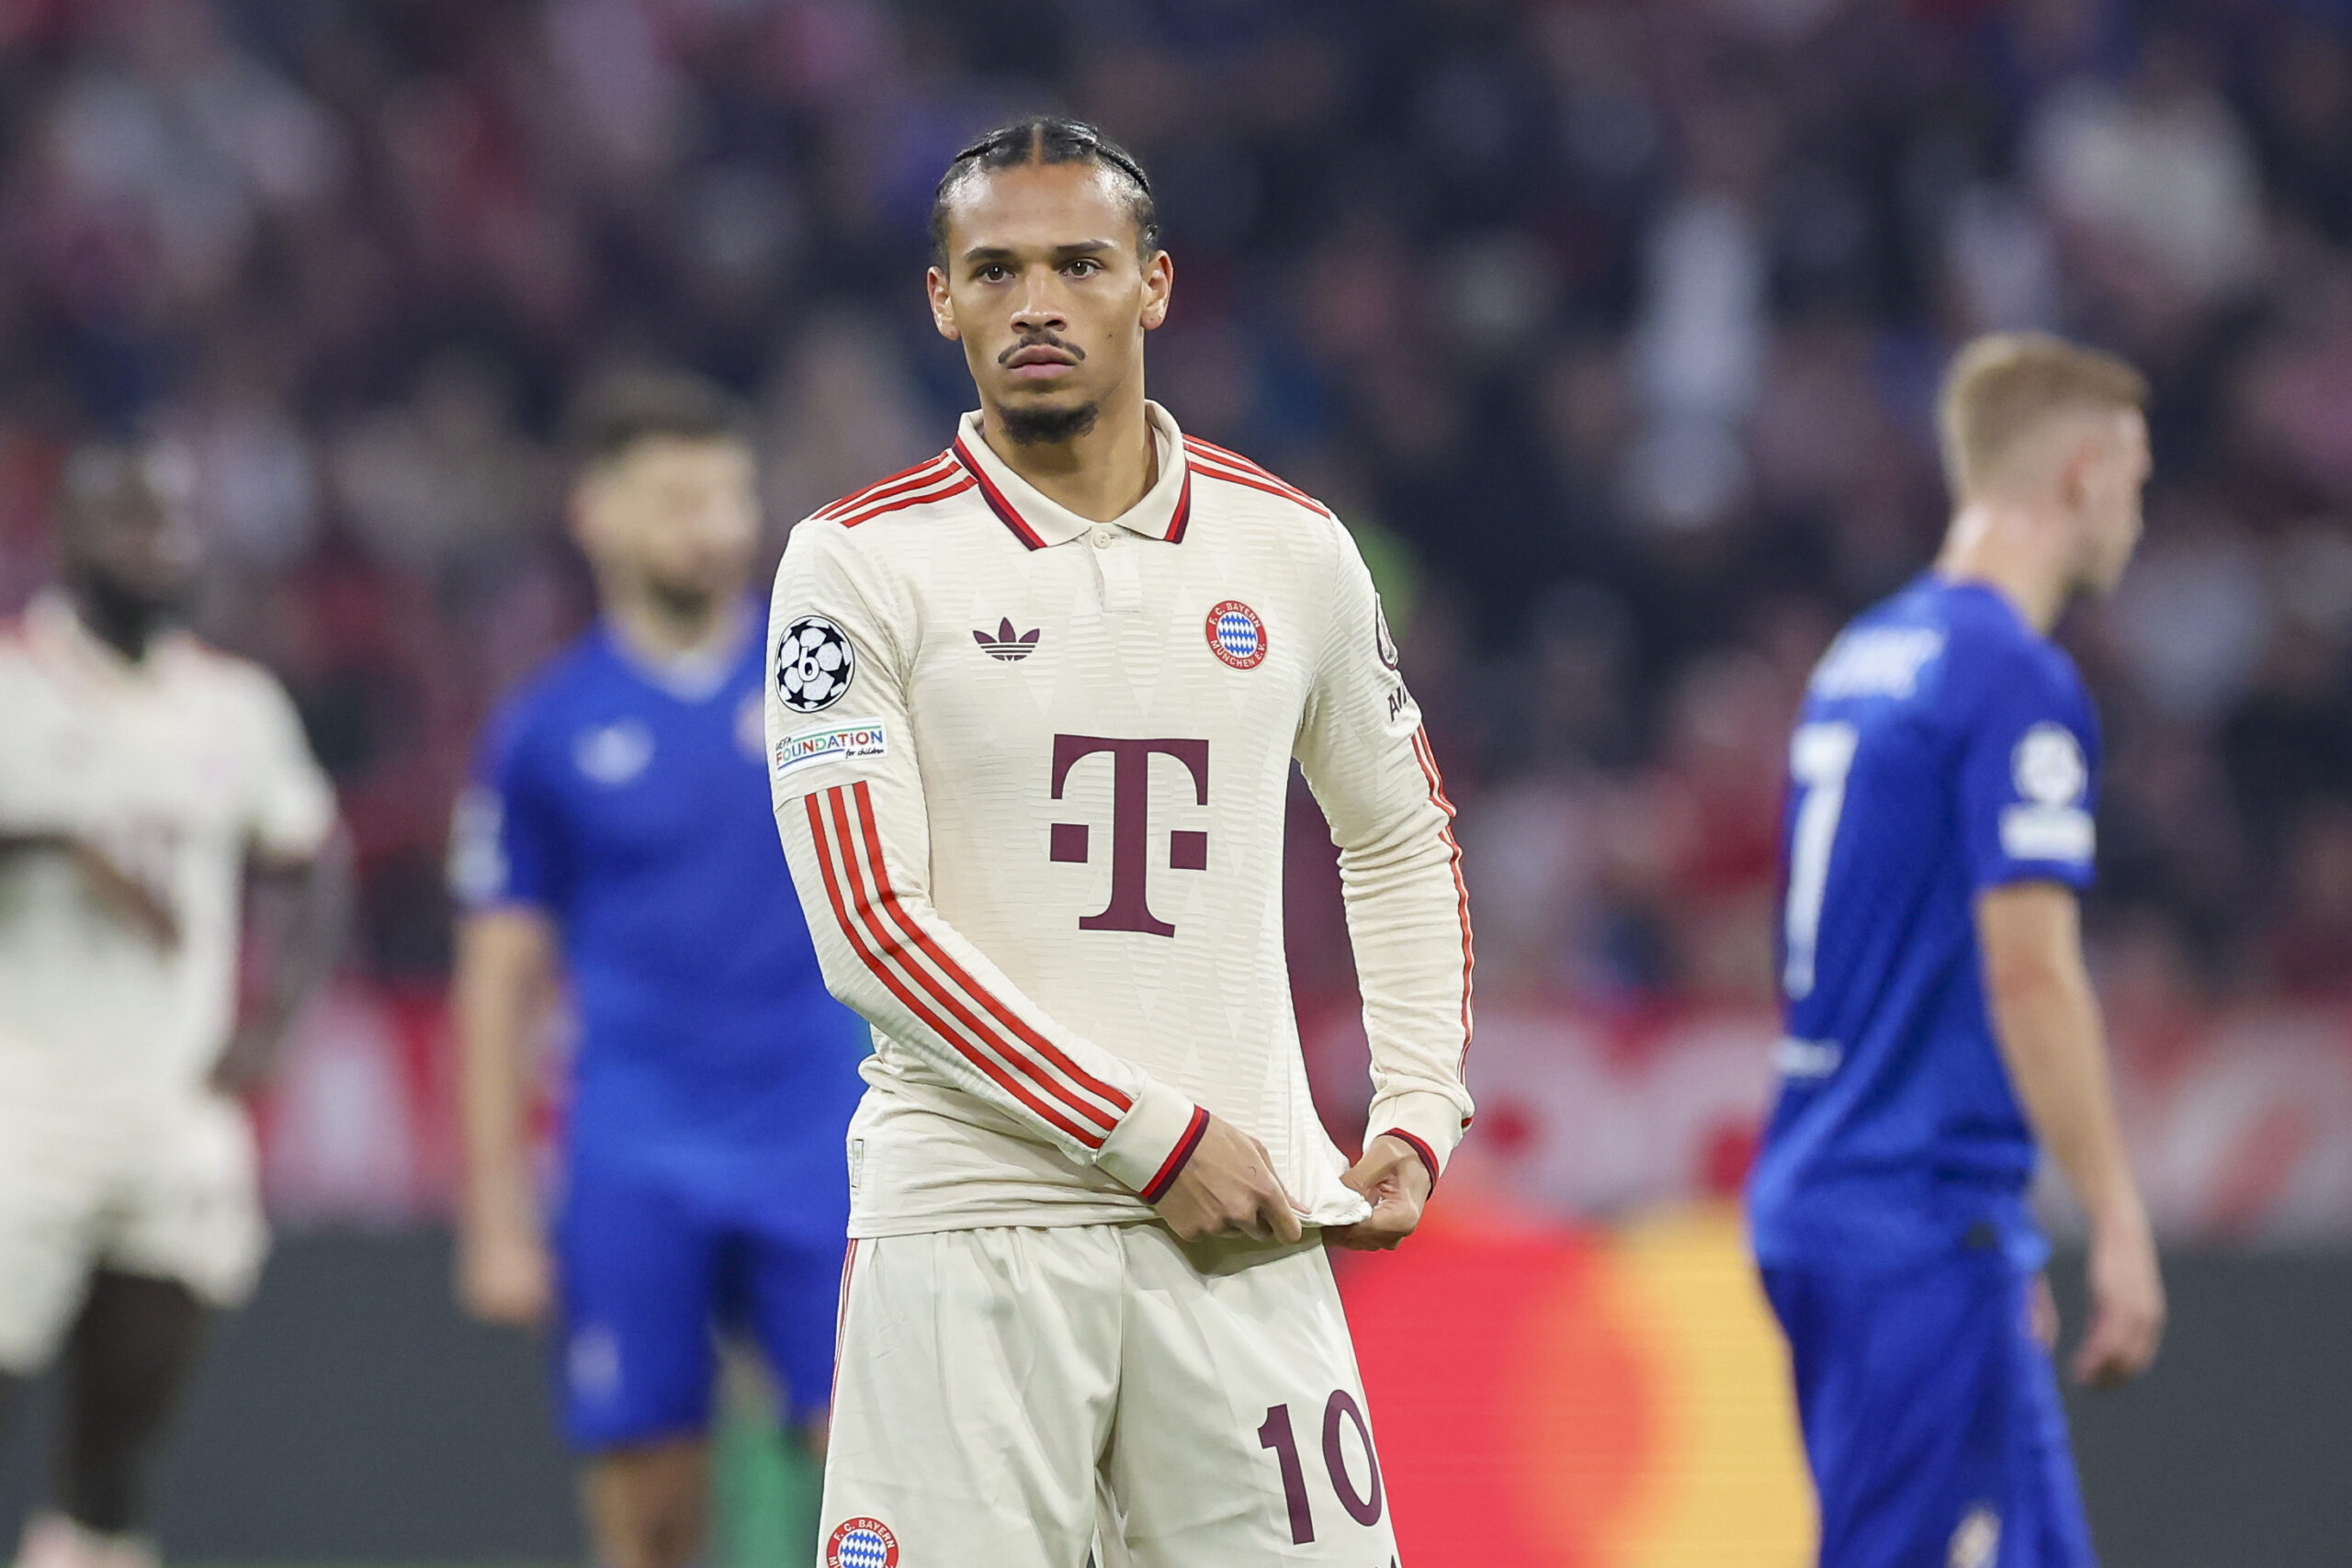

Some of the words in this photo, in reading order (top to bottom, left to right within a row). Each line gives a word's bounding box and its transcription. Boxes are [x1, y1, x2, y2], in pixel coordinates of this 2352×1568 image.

[1226, 603, 1261, 628] BAYERN
[797, 646, 820, 682] 6
[775, 736, 793, 751] UEFA
[845, 749, 856, 760] for
[857, 747, 885, 756] children
[1050, 734, 1209, 938] T
[1257, 1389, 1383, 1546] 10
[858, 1519, 896, 1549] BAYERN
